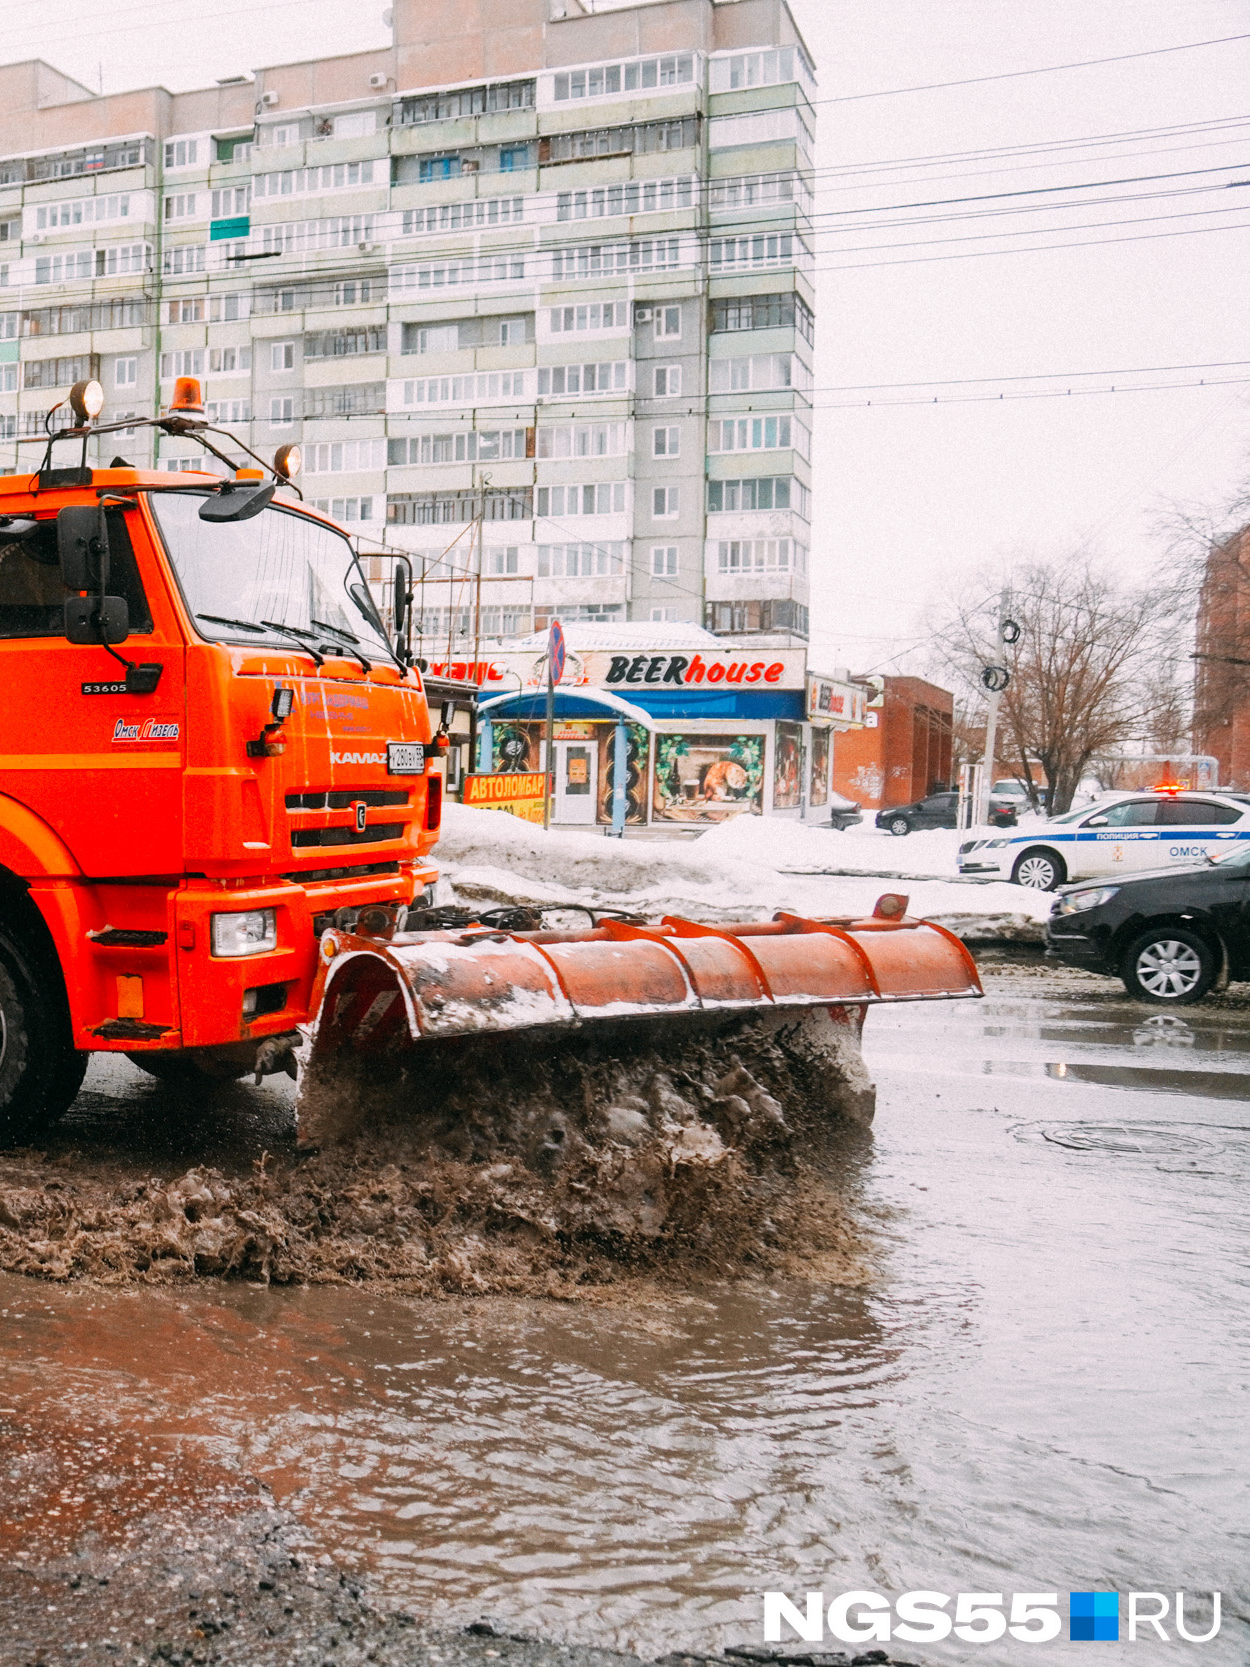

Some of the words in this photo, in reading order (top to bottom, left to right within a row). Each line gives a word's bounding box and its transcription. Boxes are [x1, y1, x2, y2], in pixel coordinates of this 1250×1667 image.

[605, 654, 785, 685] BEERhouse
[83, 684, 127, 693] 53605
[331, 751, 388, 764] KAMAZ
[470, 775, 545, 800] АВТОЛОМБАР
[1169, 846, 1208, 857] ОМСК
